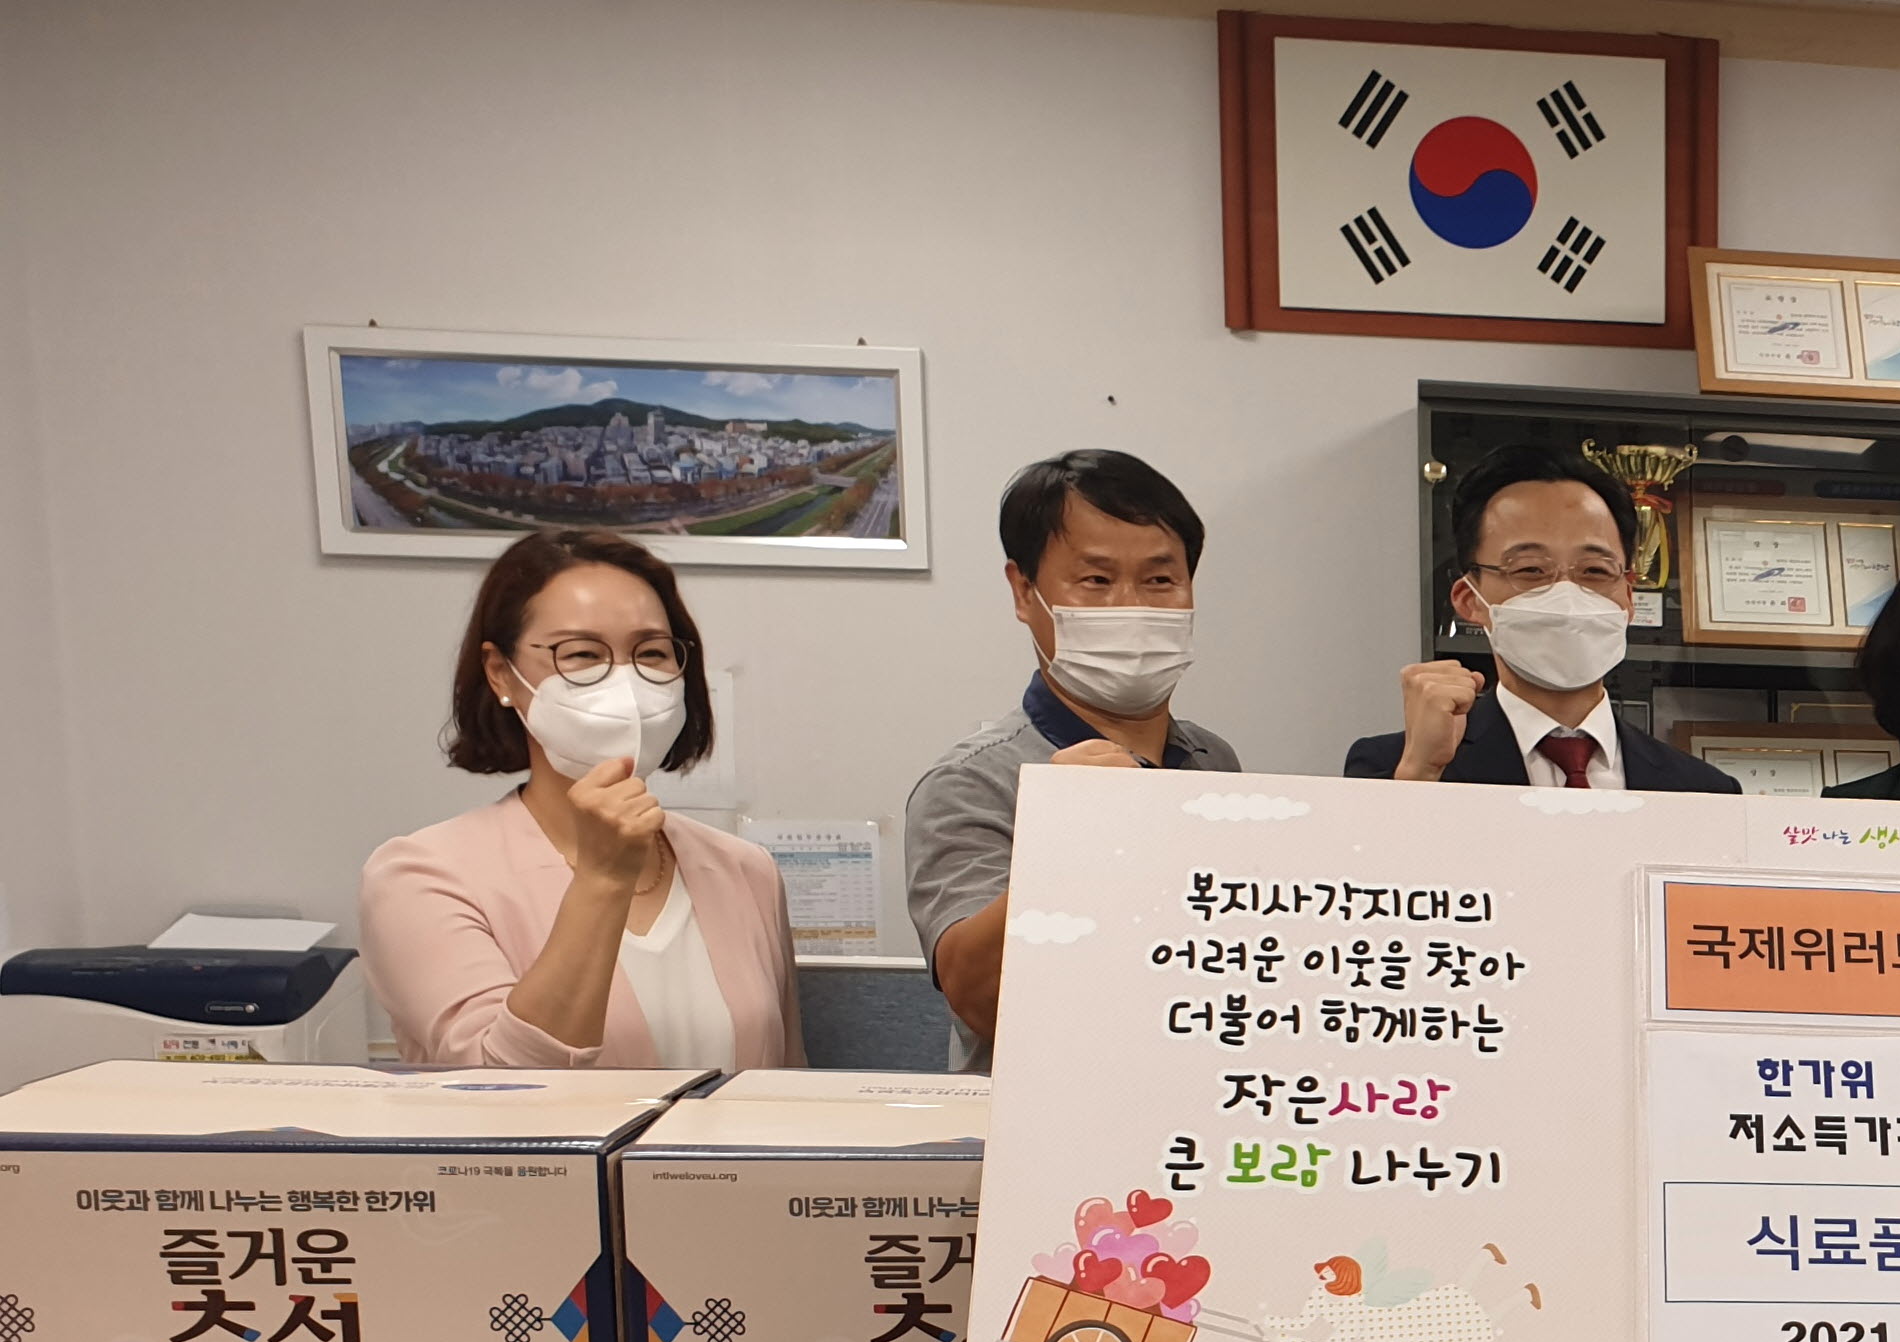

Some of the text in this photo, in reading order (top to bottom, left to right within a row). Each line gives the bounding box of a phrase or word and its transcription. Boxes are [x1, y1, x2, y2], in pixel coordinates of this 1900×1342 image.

[1186, 872, 1493, 923] 복지사각지대의
[1151, 935, 1526, 990] 어려운 이웃을 찾아
[1168, 993, 1505, 1053] 더불어 함께하는
[1755, 1057, 1875, 1100] 한가위
[1164, 1135, 1501, 1191] 큰 보람 나누기
[76, 1188, 437, 1214] 이웃과 함께 나누는 행복한 한가위
[788, 1195, 909, 1219] 이웃과 함께
[159, 1226, 357, 1288] 즐거운
